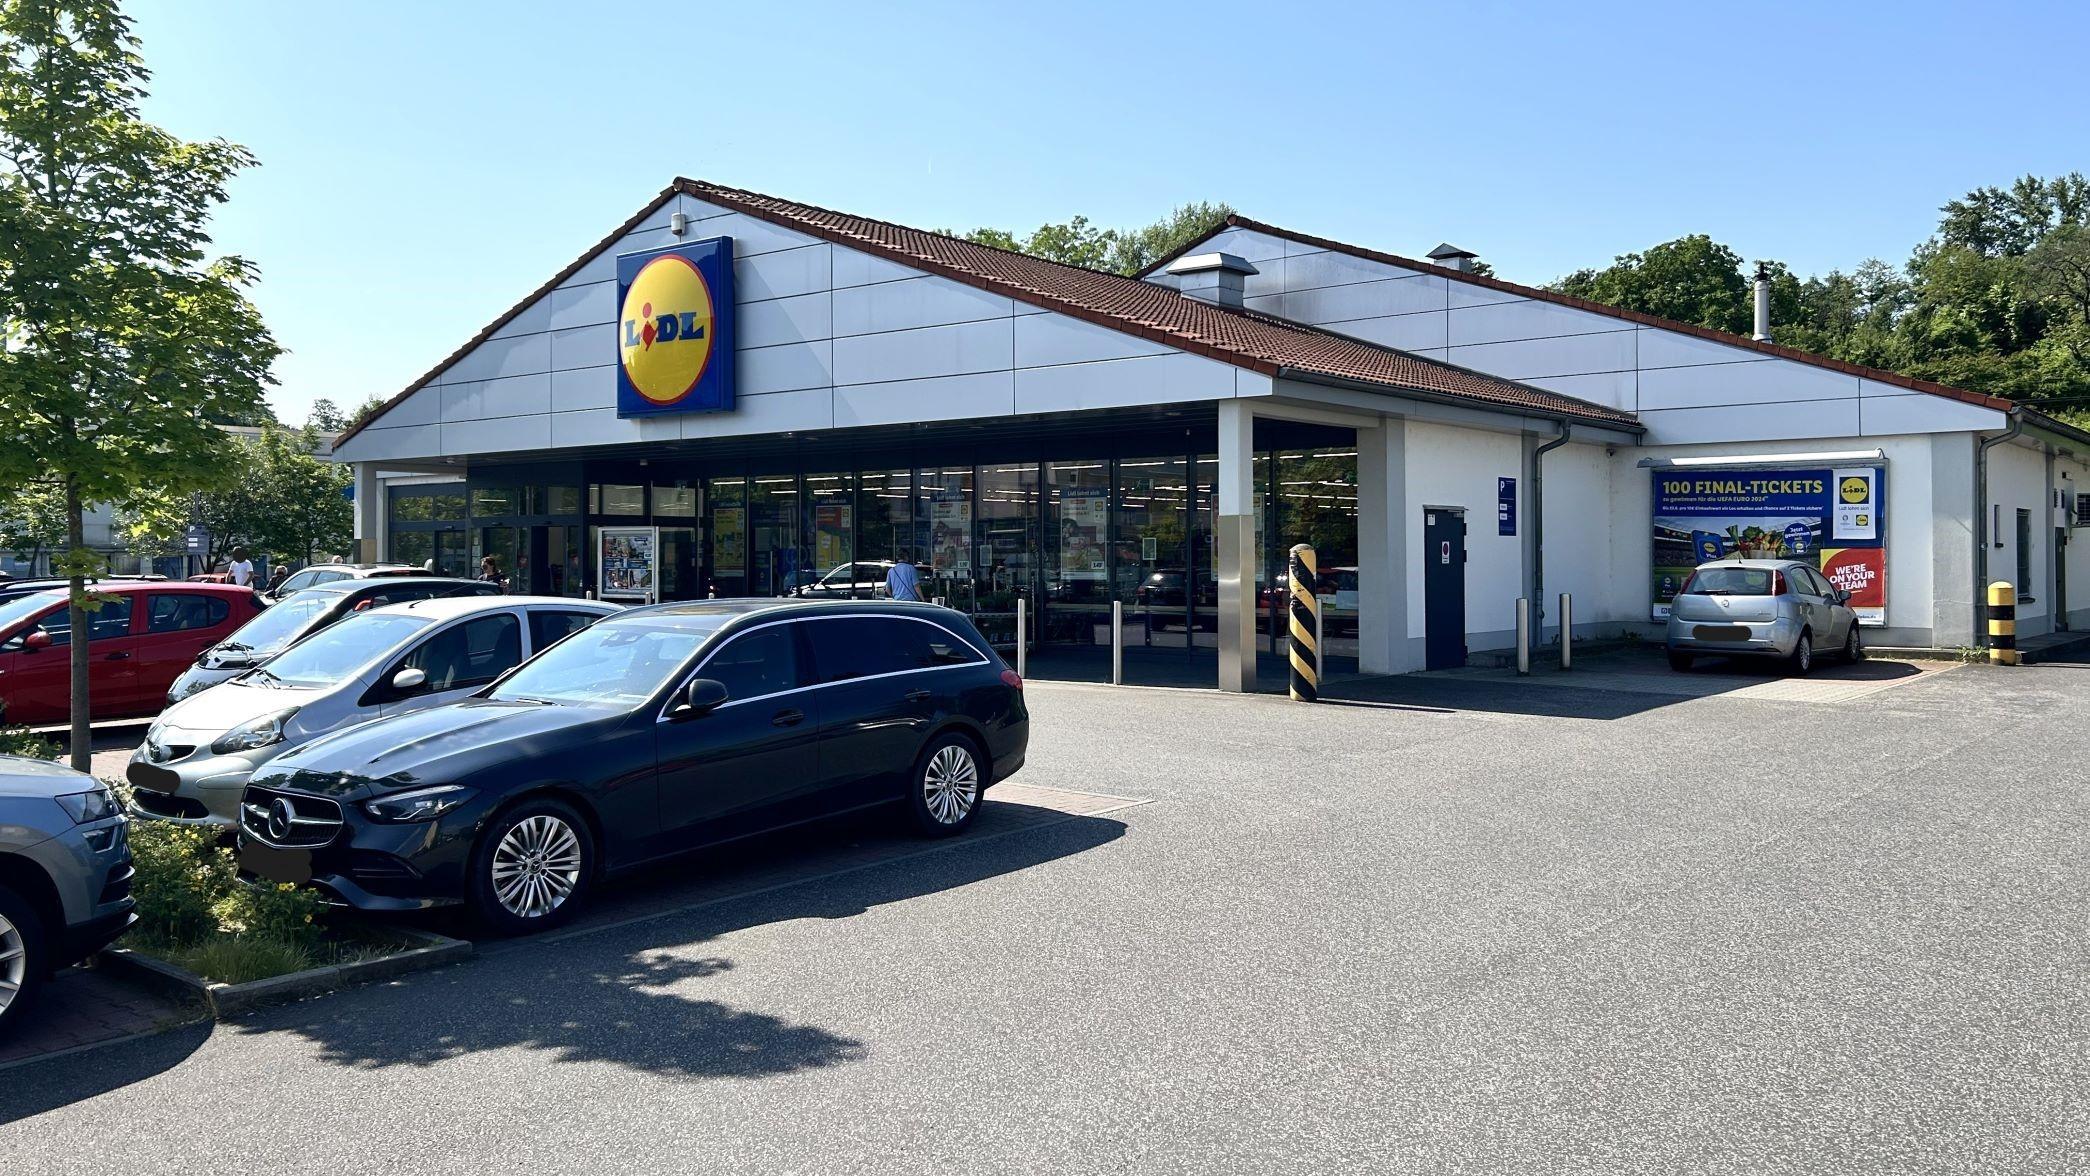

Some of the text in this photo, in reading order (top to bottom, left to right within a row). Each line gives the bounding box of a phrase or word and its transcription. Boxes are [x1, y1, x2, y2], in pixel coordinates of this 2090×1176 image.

[1500, 480, 1505, 493] P
[1663, 480, 1822, 494] 100 FINAL-TICKETS
[1835, 563, 1867, 575] WE'RE
[1829, 570, 1875, 584] ON YOUR
[1839, 580, 1868, 590] TEAM
